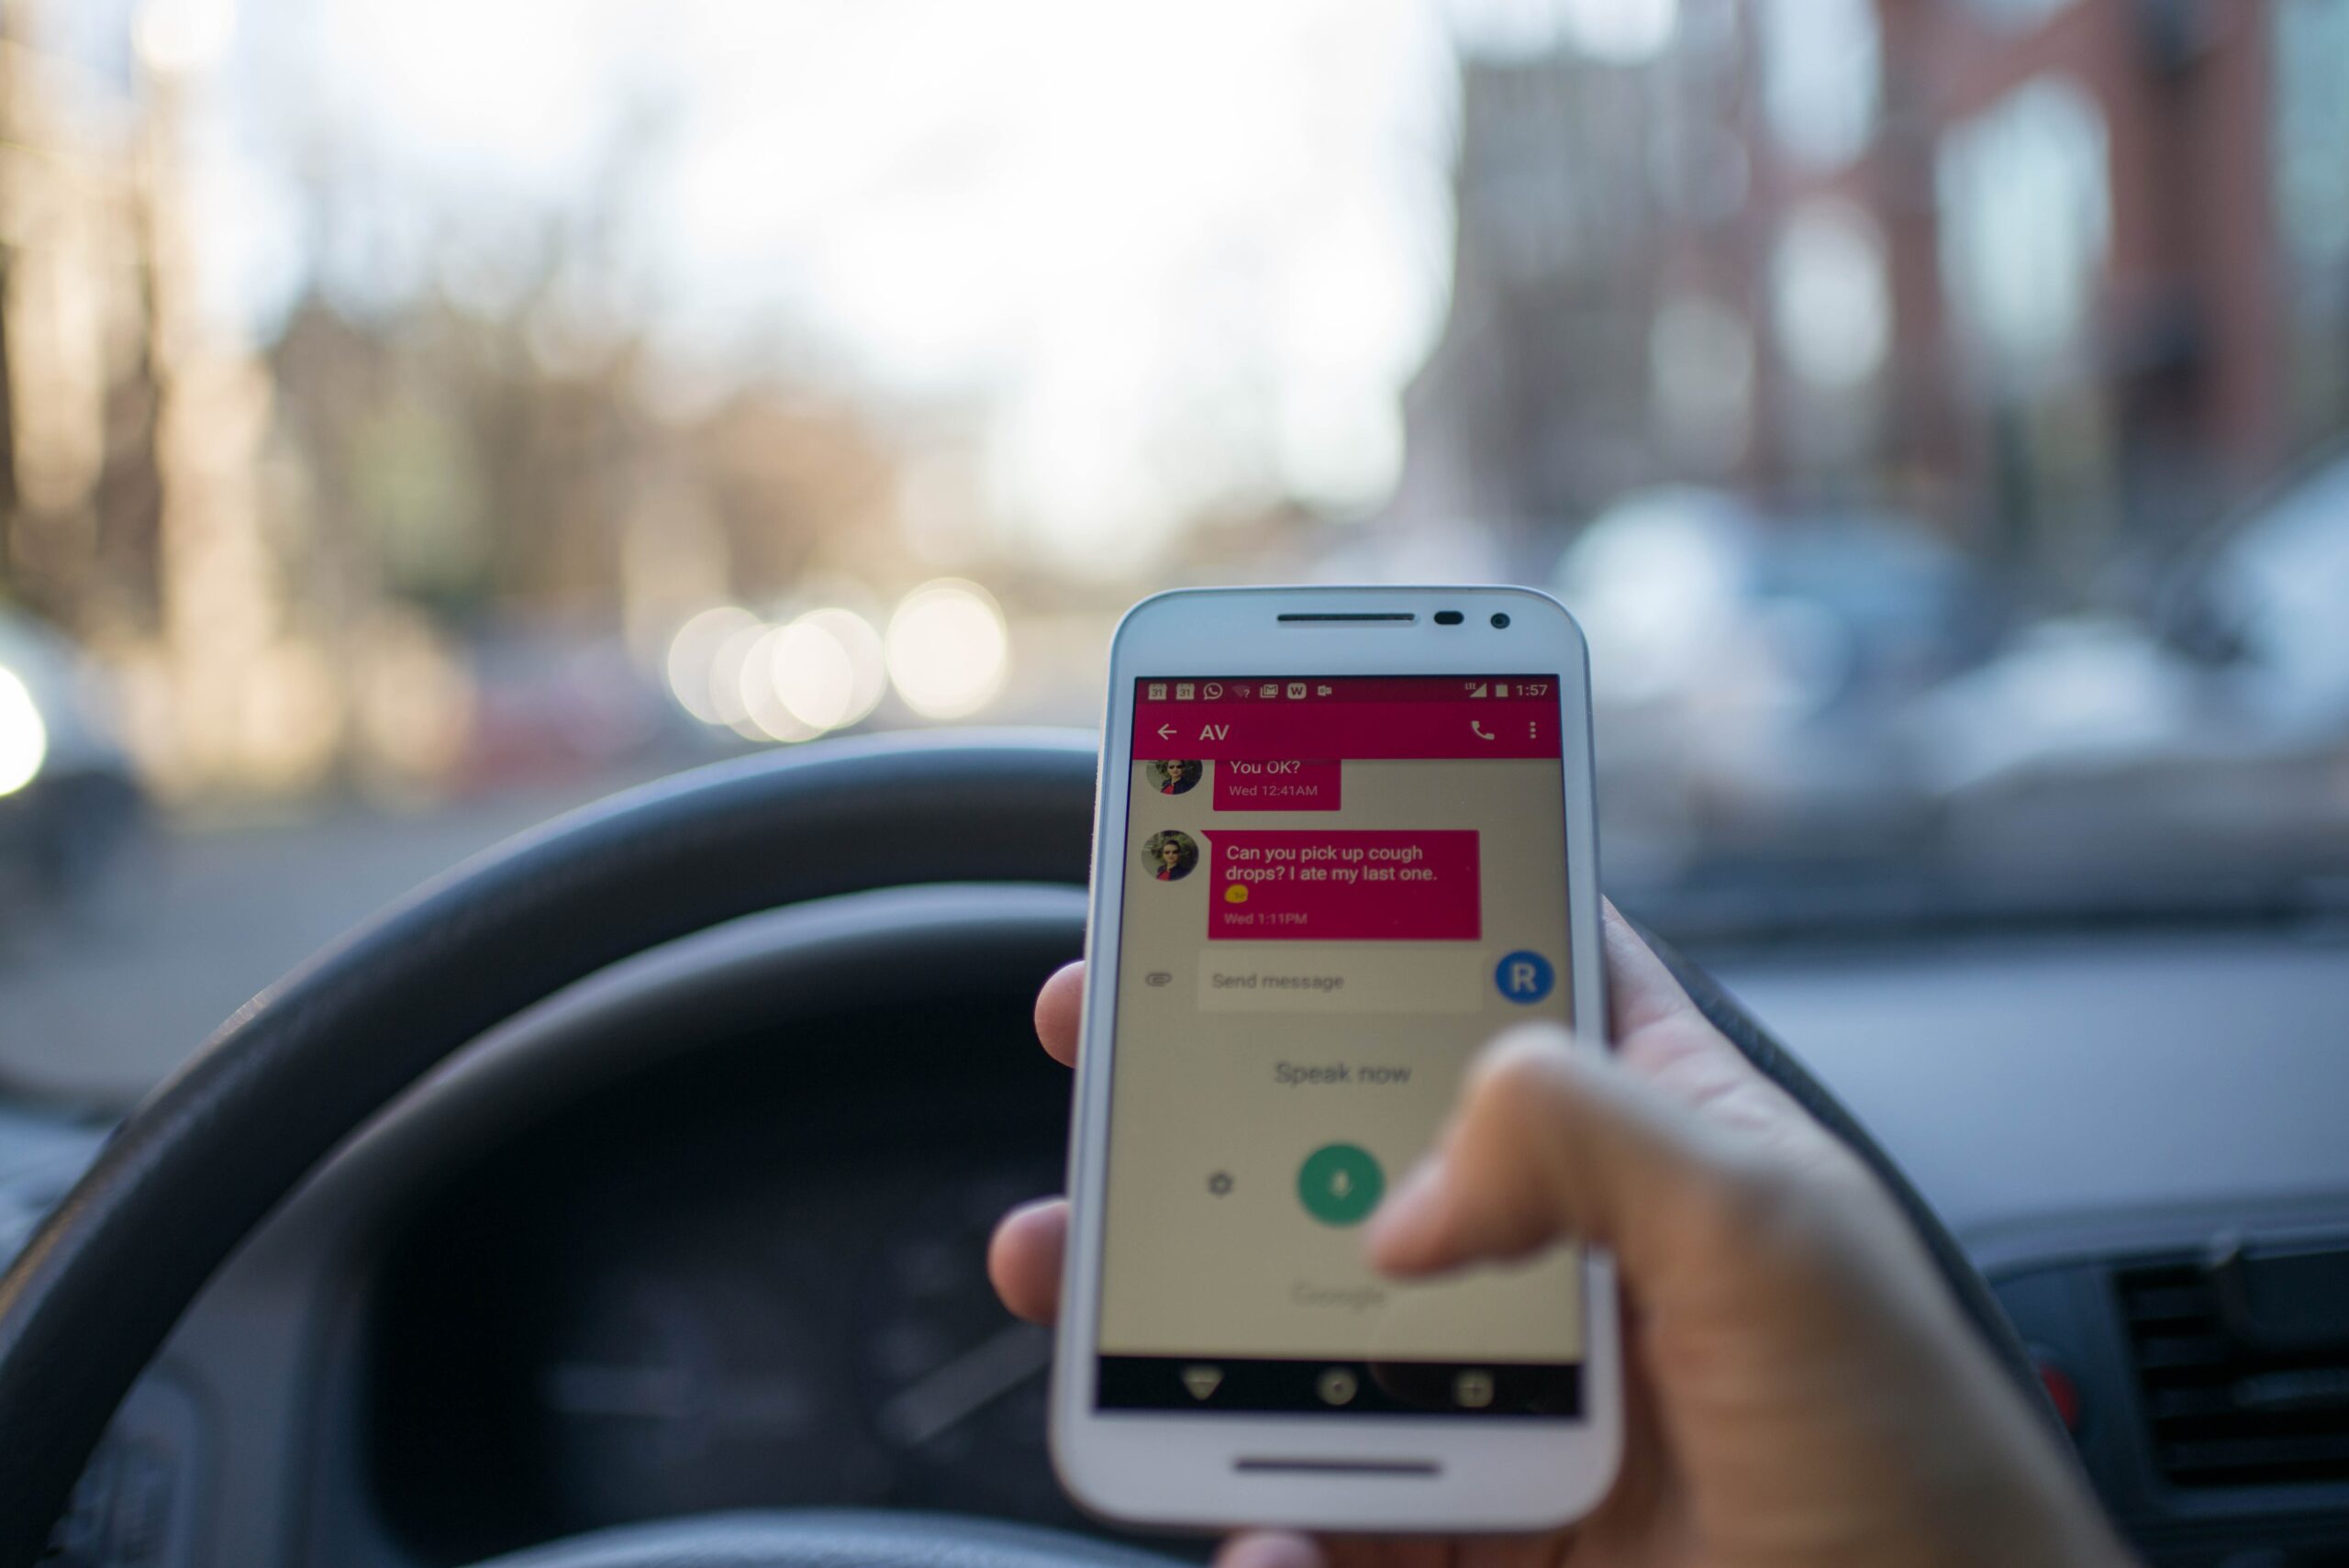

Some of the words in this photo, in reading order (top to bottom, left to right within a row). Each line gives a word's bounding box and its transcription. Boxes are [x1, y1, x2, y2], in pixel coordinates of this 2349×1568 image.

[1516, 684, 1548, 696] 1:57
[1199, 725, 1230, 740] AV
[1230, 761, 1262, 774] You
[1266, 761, 1301, 774] OK?
[1229, 785, 1258, 796] Wed
[1262, 785, 1319, 796] 12:41AM
[1226, 846, 1261, 861] Can
[1265, 849, 1296, 863] you
[1300, 845, 1338, 863] pick
[1341, 849, 1364, 863] up
[1369, 845, 1423, 863] cough
[1225, 866, 1286, 884] drops?
[1299, 867, 1327, 881] ate
[1332, 869, 1359, 884] my
[1363, 866, 1396, 881] last
[1400, 869, 1438, 881] one.
[1224, 913, 1254, 925] Wed
[1258, 913, 1308, 925] 1:11PM
[1212, 973, 1257, 990] Send
[1262, 975, 1344, 993] message
[1512, 963, 1537, 993] R
[1275, 1062, 1351, 1087] Speak
[1359, 1068, 1411, 1084] now
